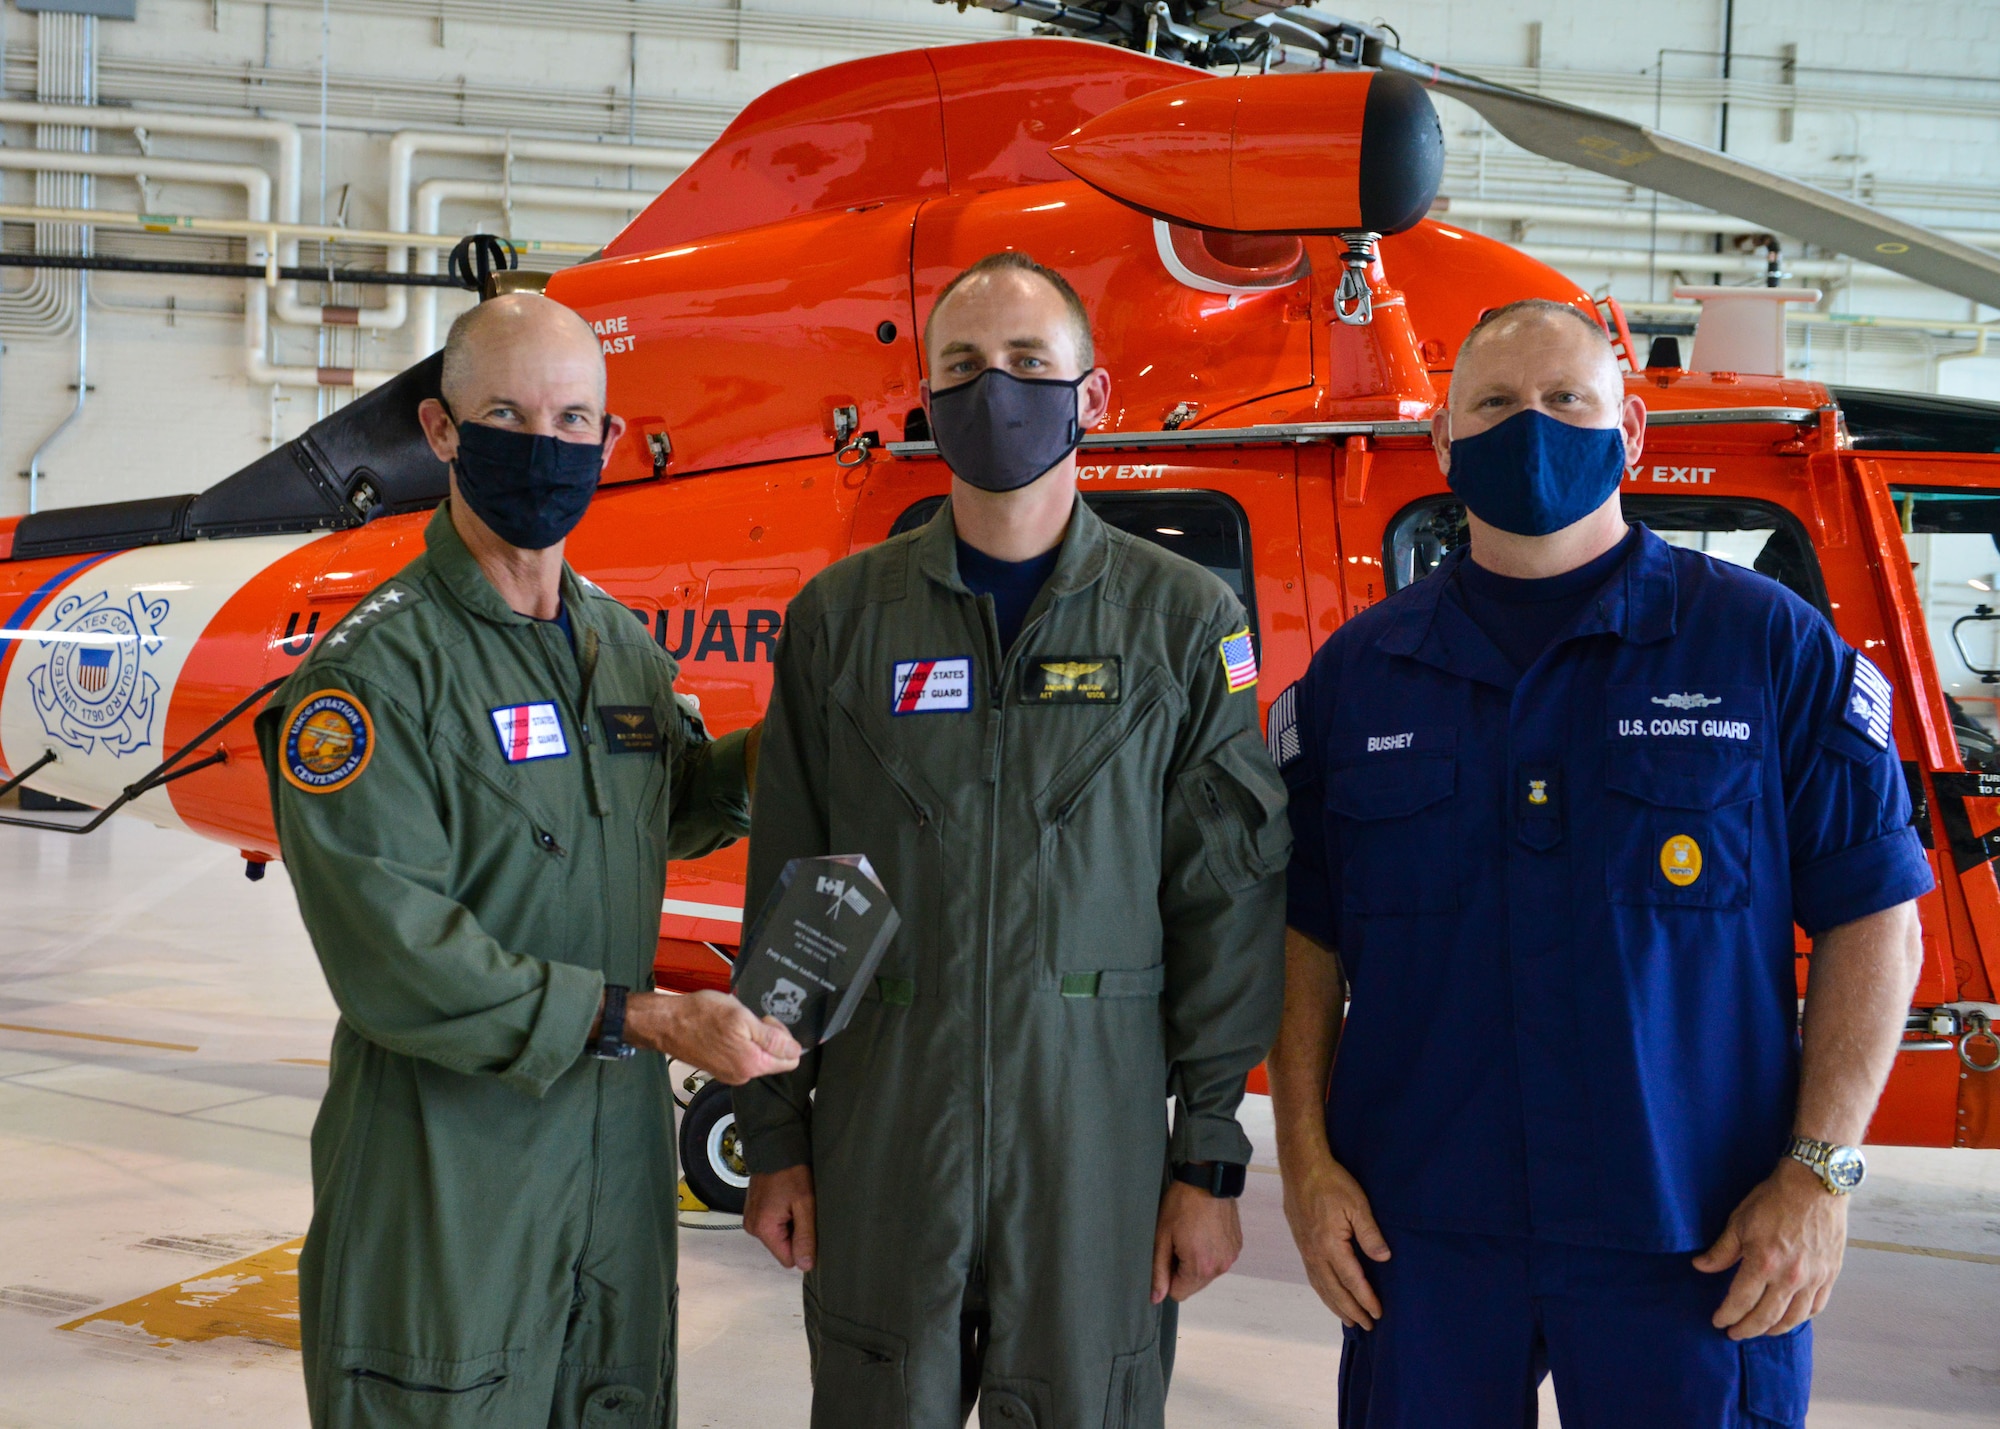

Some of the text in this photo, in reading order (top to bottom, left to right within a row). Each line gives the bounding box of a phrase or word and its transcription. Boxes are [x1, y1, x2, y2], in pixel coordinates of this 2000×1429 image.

[588, 316, 629, 335] ARE
[1115, 464, 1168, 479] EXIT
[1652, 465, 1717, 485] EXIT
[631, 609, 783, 663] UAR
[54, 655, 78, 713] UNITED
[104, 663, 134, 717] GUARD
[897, 670, 964, 683] UNITED STATES
[900, 688, 962, 701] COAST GUARD
[81, 708, 104, 723] 1790
[290, 698, 360, 735] USCG AVIATION
[1618, 719, 1750, 741] U.S. COAST GUARD
[1367, 731, 1415, 753] BUSHEY
[293, 755, 362, 785] CENTENNIAL
[1978, 785, 1993, 794] TO
